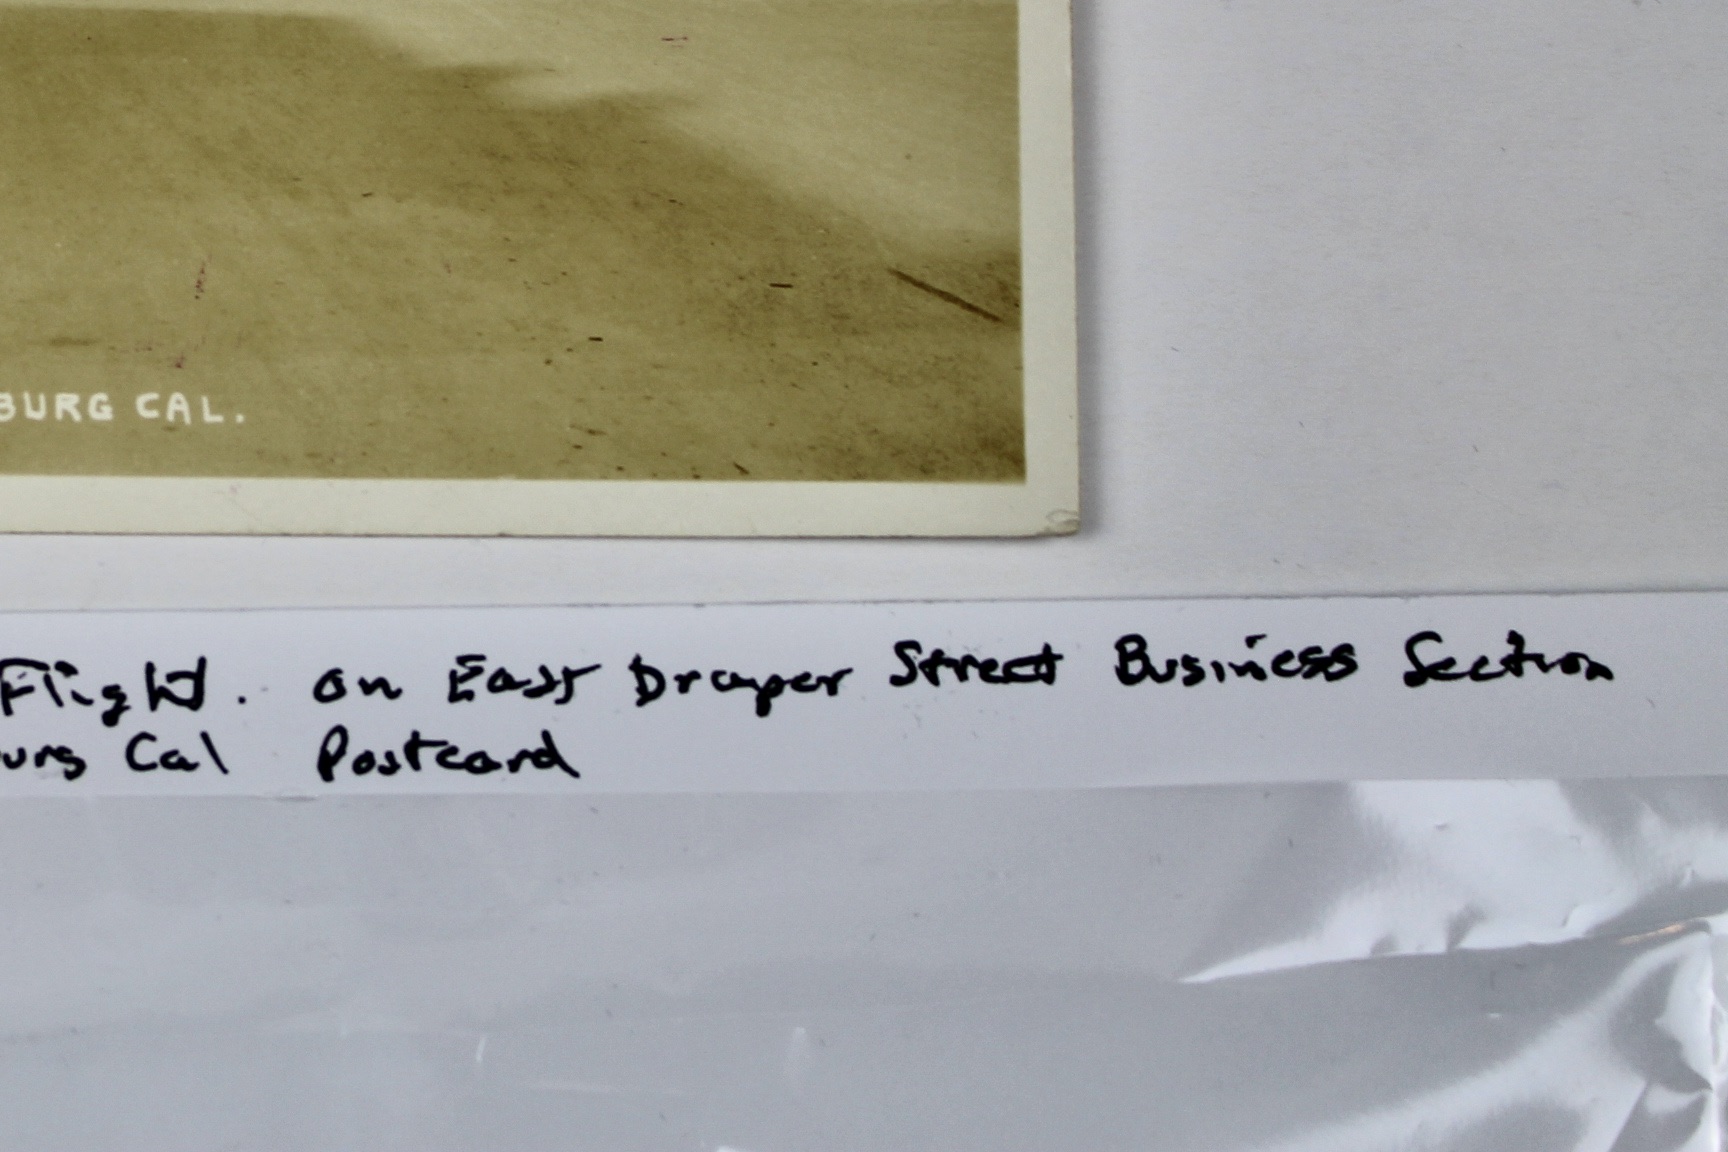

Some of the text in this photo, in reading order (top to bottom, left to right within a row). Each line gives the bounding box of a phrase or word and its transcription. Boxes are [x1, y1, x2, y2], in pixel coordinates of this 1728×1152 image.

[134, 390, 246, 426] CAL.
[447, 654, 603, 707] East
[628, 654, 855, 718] Draper
[888, 639, 1065, 688] Street
[1113, 633, 1360, 688] Business
[1401, 629, 1616, 689] Section
[125, 730, 230, 776] Cal
[315, 724, 582, 783] Postcard
